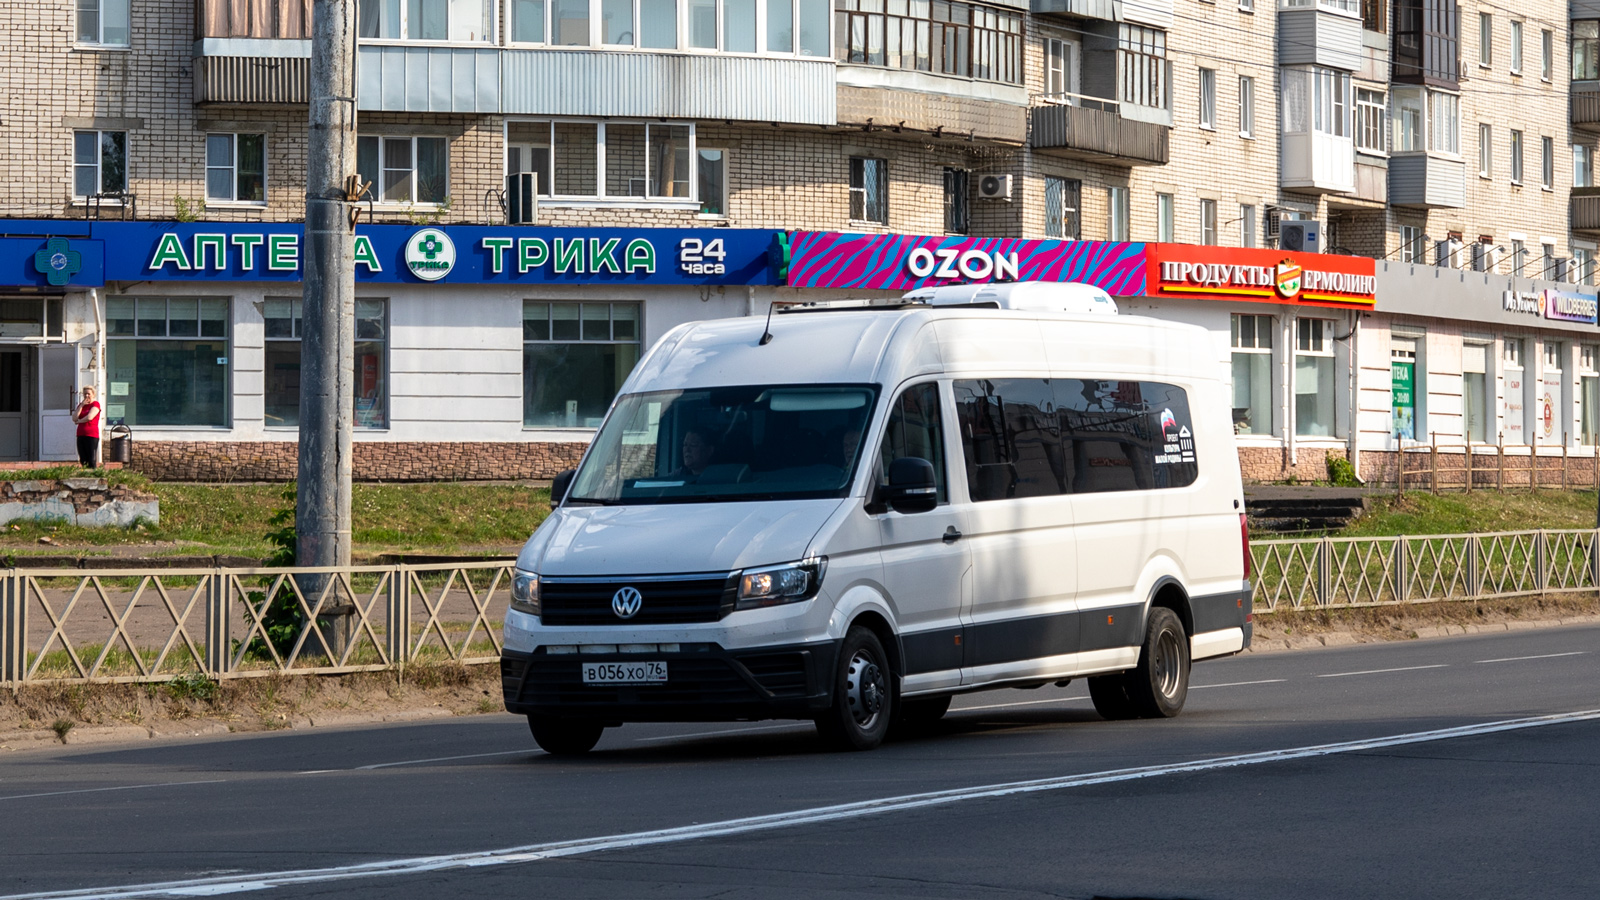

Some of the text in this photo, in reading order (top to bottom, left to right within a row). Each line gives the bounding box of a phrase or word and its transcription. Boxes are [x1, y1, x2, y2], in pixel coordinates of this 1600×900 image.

[150, 232, 382, 272] АПТЕА
[482, 237, 656, 274] ТРИКА
[680, 238, 726, 263] 24
[409, 261, 450, 270] ТРИКА
[681, 262, 725, 275] часа
[908, 247, 1019, 281] OZON
[1162, 261, 1275, 287] ПРОДУКТЫ
[1303, 269, 1378, 295] ЕРМОЛИНО
[1555, 296, 1597, 317] WILDBERRIES
[1392, 366, 1409, 381] ТЕКА
[648, 663, 662, 675] 76
